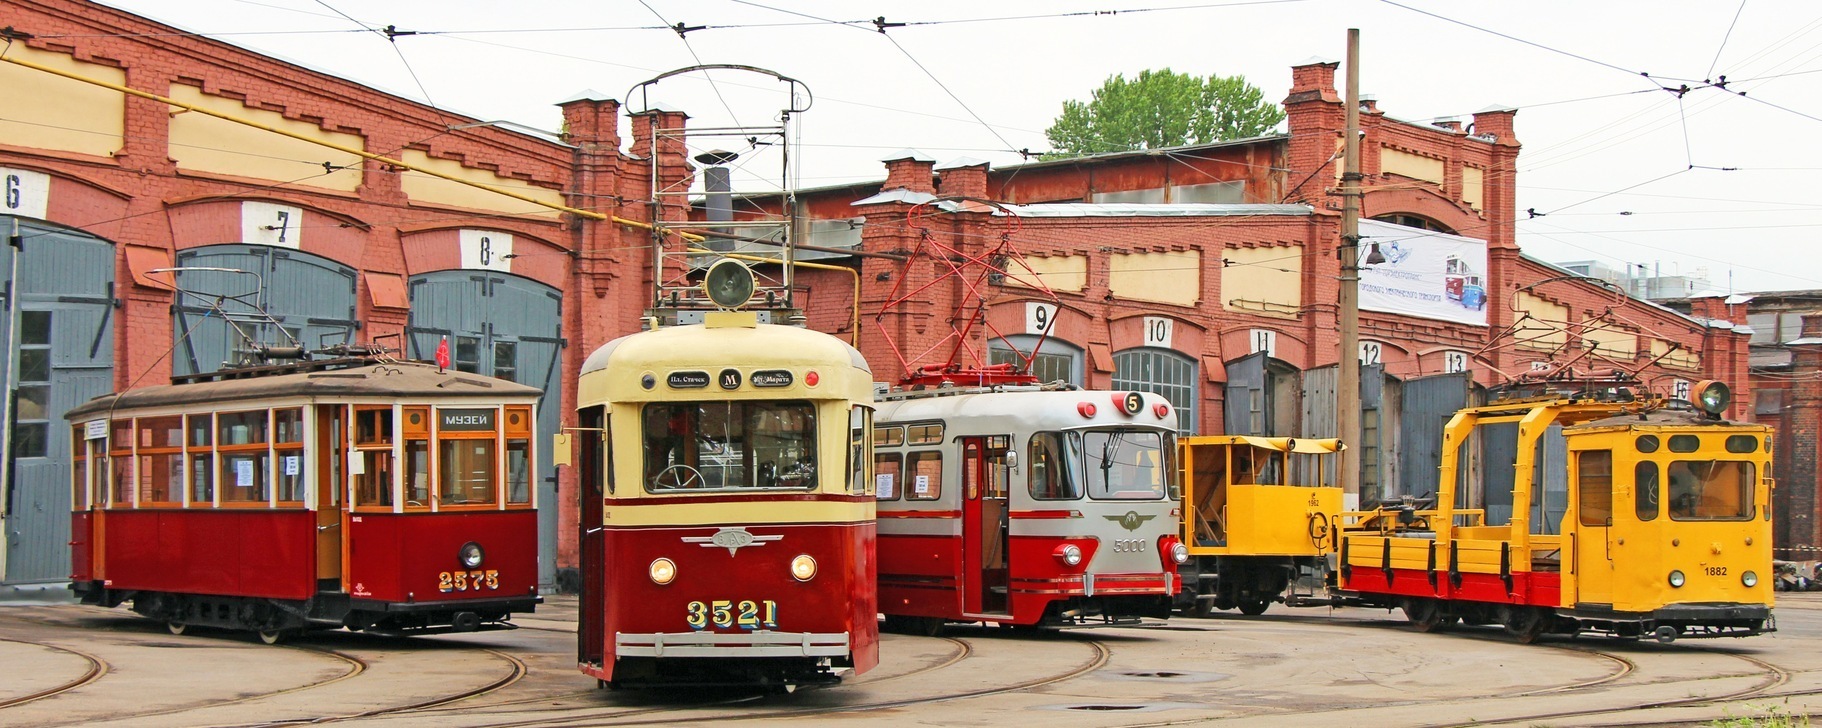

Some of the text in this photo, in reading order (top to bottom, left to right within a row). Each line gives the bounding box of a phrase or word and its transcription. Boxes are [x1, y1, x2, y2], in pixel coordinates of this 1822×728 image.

[7, 174, 20, 209] 6
[277, 210, 289, 243] 7
[480, 236, 490, 266] 8
[1036, 305, 1047, 330] 9
[1149, 319, 1166, 342] 10
[1257, 331, 1269, 356] 11
[1363, 343, 1379, 364] 12
[1448, 353, 1462, 372] 13
[1128, 396, 1138, 411] 5
[445, 414, 487, 425] МУЗЕЙ
[1113, 538, 1146, 553] 5000
[438, 570, 499, 593] 2575
[1705, 566, 1727, 576] 1882
[686, 600, 777, 630] 3521
